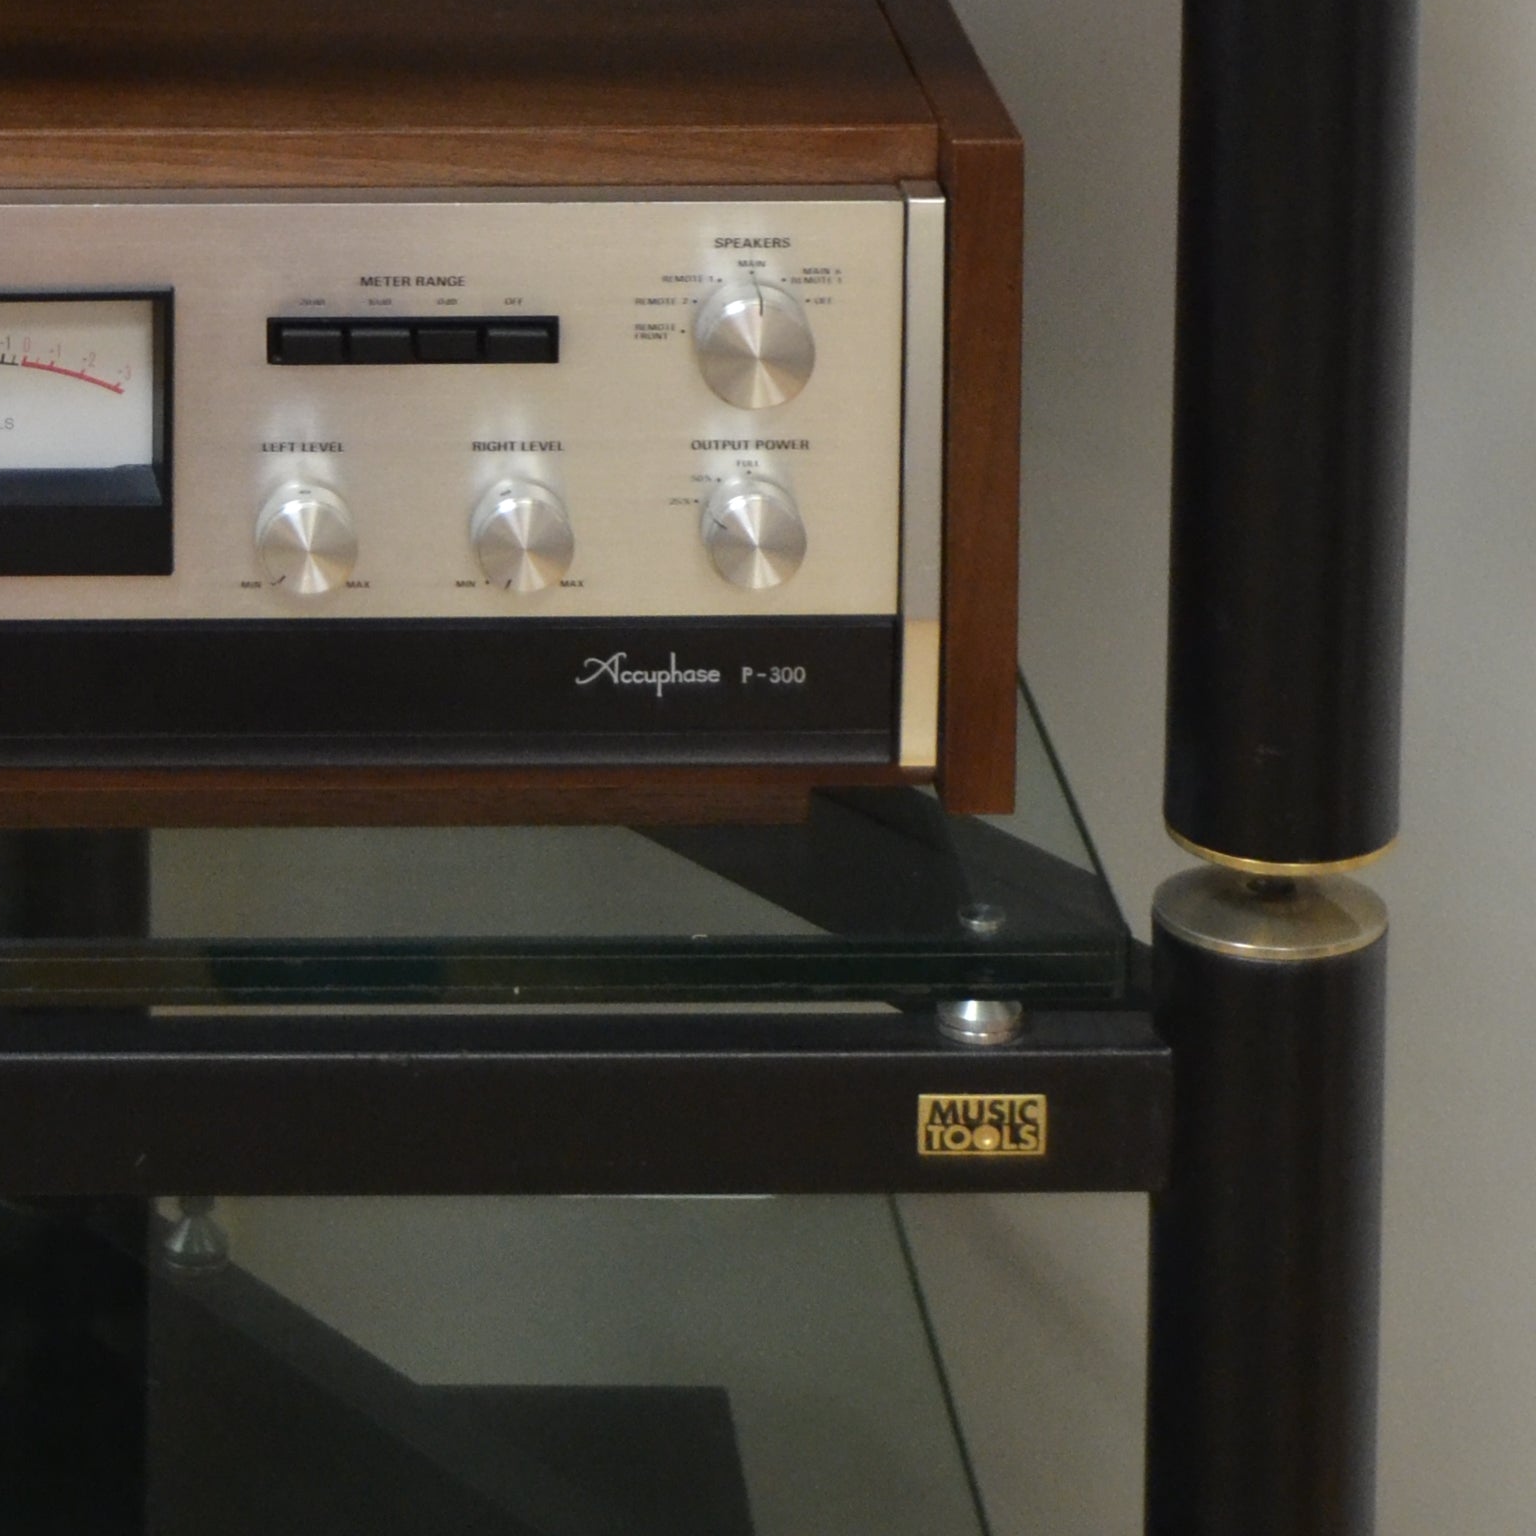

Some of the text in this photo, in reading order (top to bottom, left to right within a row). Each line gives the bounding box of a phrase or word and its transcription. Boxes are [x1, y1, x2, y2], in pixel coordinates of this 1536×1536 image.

[714, 238, 791, 248] SPEAKERS
[360, 276, 465, 287] METER RANGE
[262, 442, 344, 453] LEFT LEVEL
[472, 441, 564, 452] RIGHT LEVEL
[691, 440, 809, 450] OUTPUT POWER
[456, 580, 475, 588] MIN
[560, 580, 583, 588] MAX
[575, 652, 806, 698] Accuphase P-300
[929, 1100, 1037, 1124] MUSIC
[926, 1125, 1037, 1150] TOOLS
